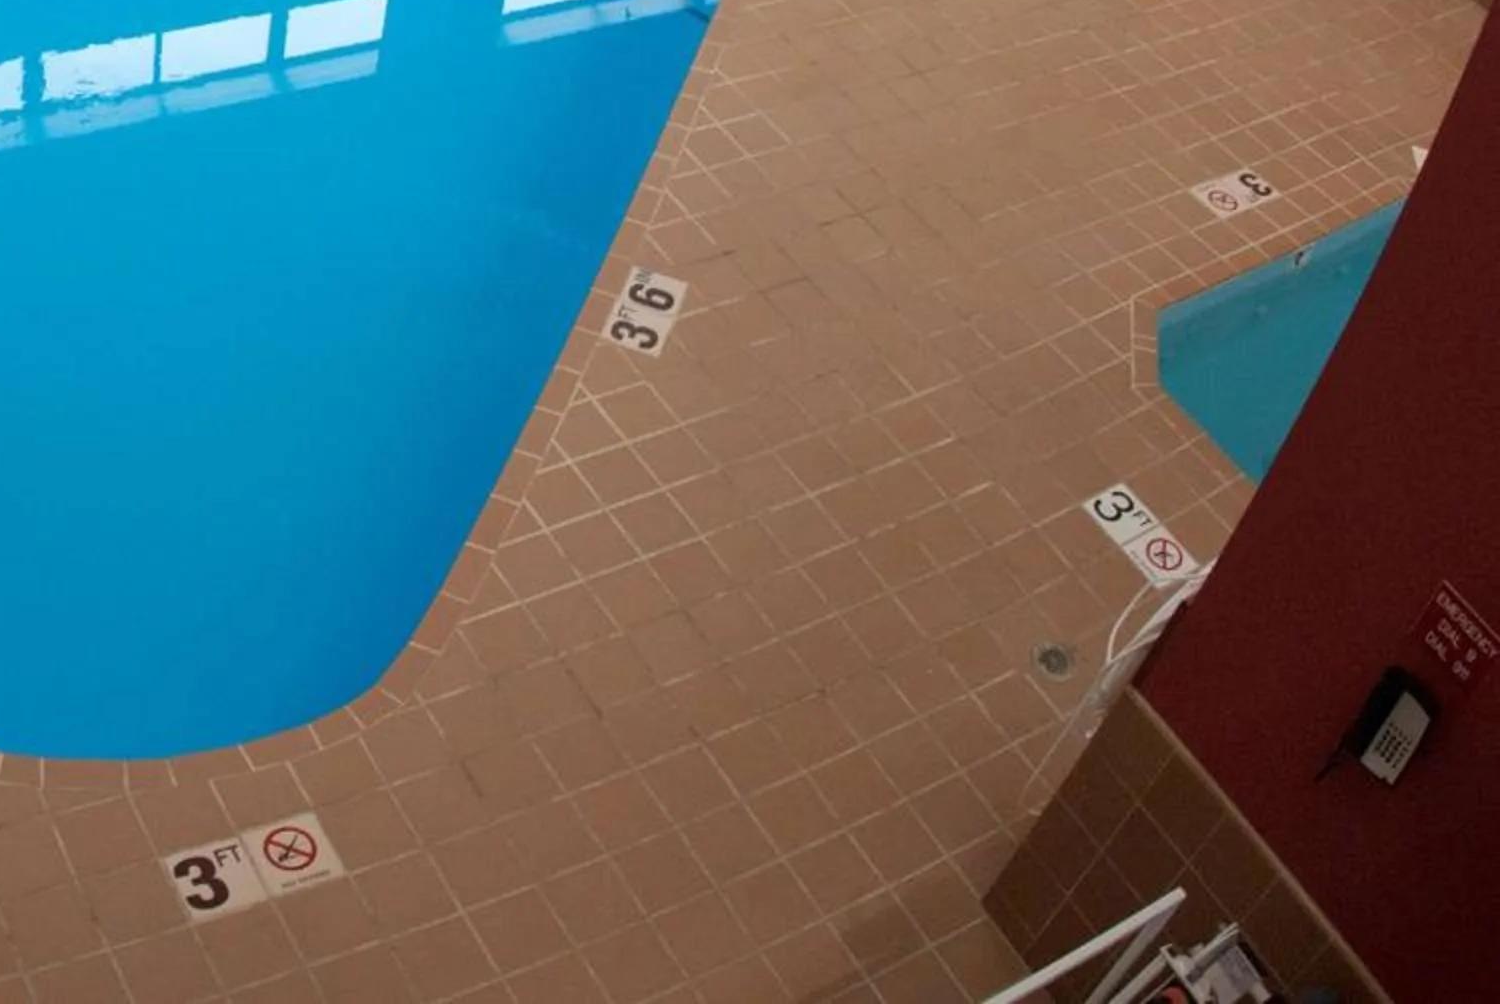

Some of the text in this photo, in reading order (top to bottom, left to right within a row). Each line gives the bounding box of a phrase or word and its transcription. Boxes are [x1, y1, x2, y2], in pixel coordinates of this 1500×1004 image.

[1239, 173, 1272, 197] 3
[628, 283, 675, 311] 6
[610, 320, 659, 350] 3
[1094, 491, 1153, 527] 3 FT
[1435, 592, 1500, 658] EMERGENCY
[1437, 618, 1461, 649] DIAL
[1424, 630, 1448, 662] DIAL
[173, 844, 241, 910] 3 FT
